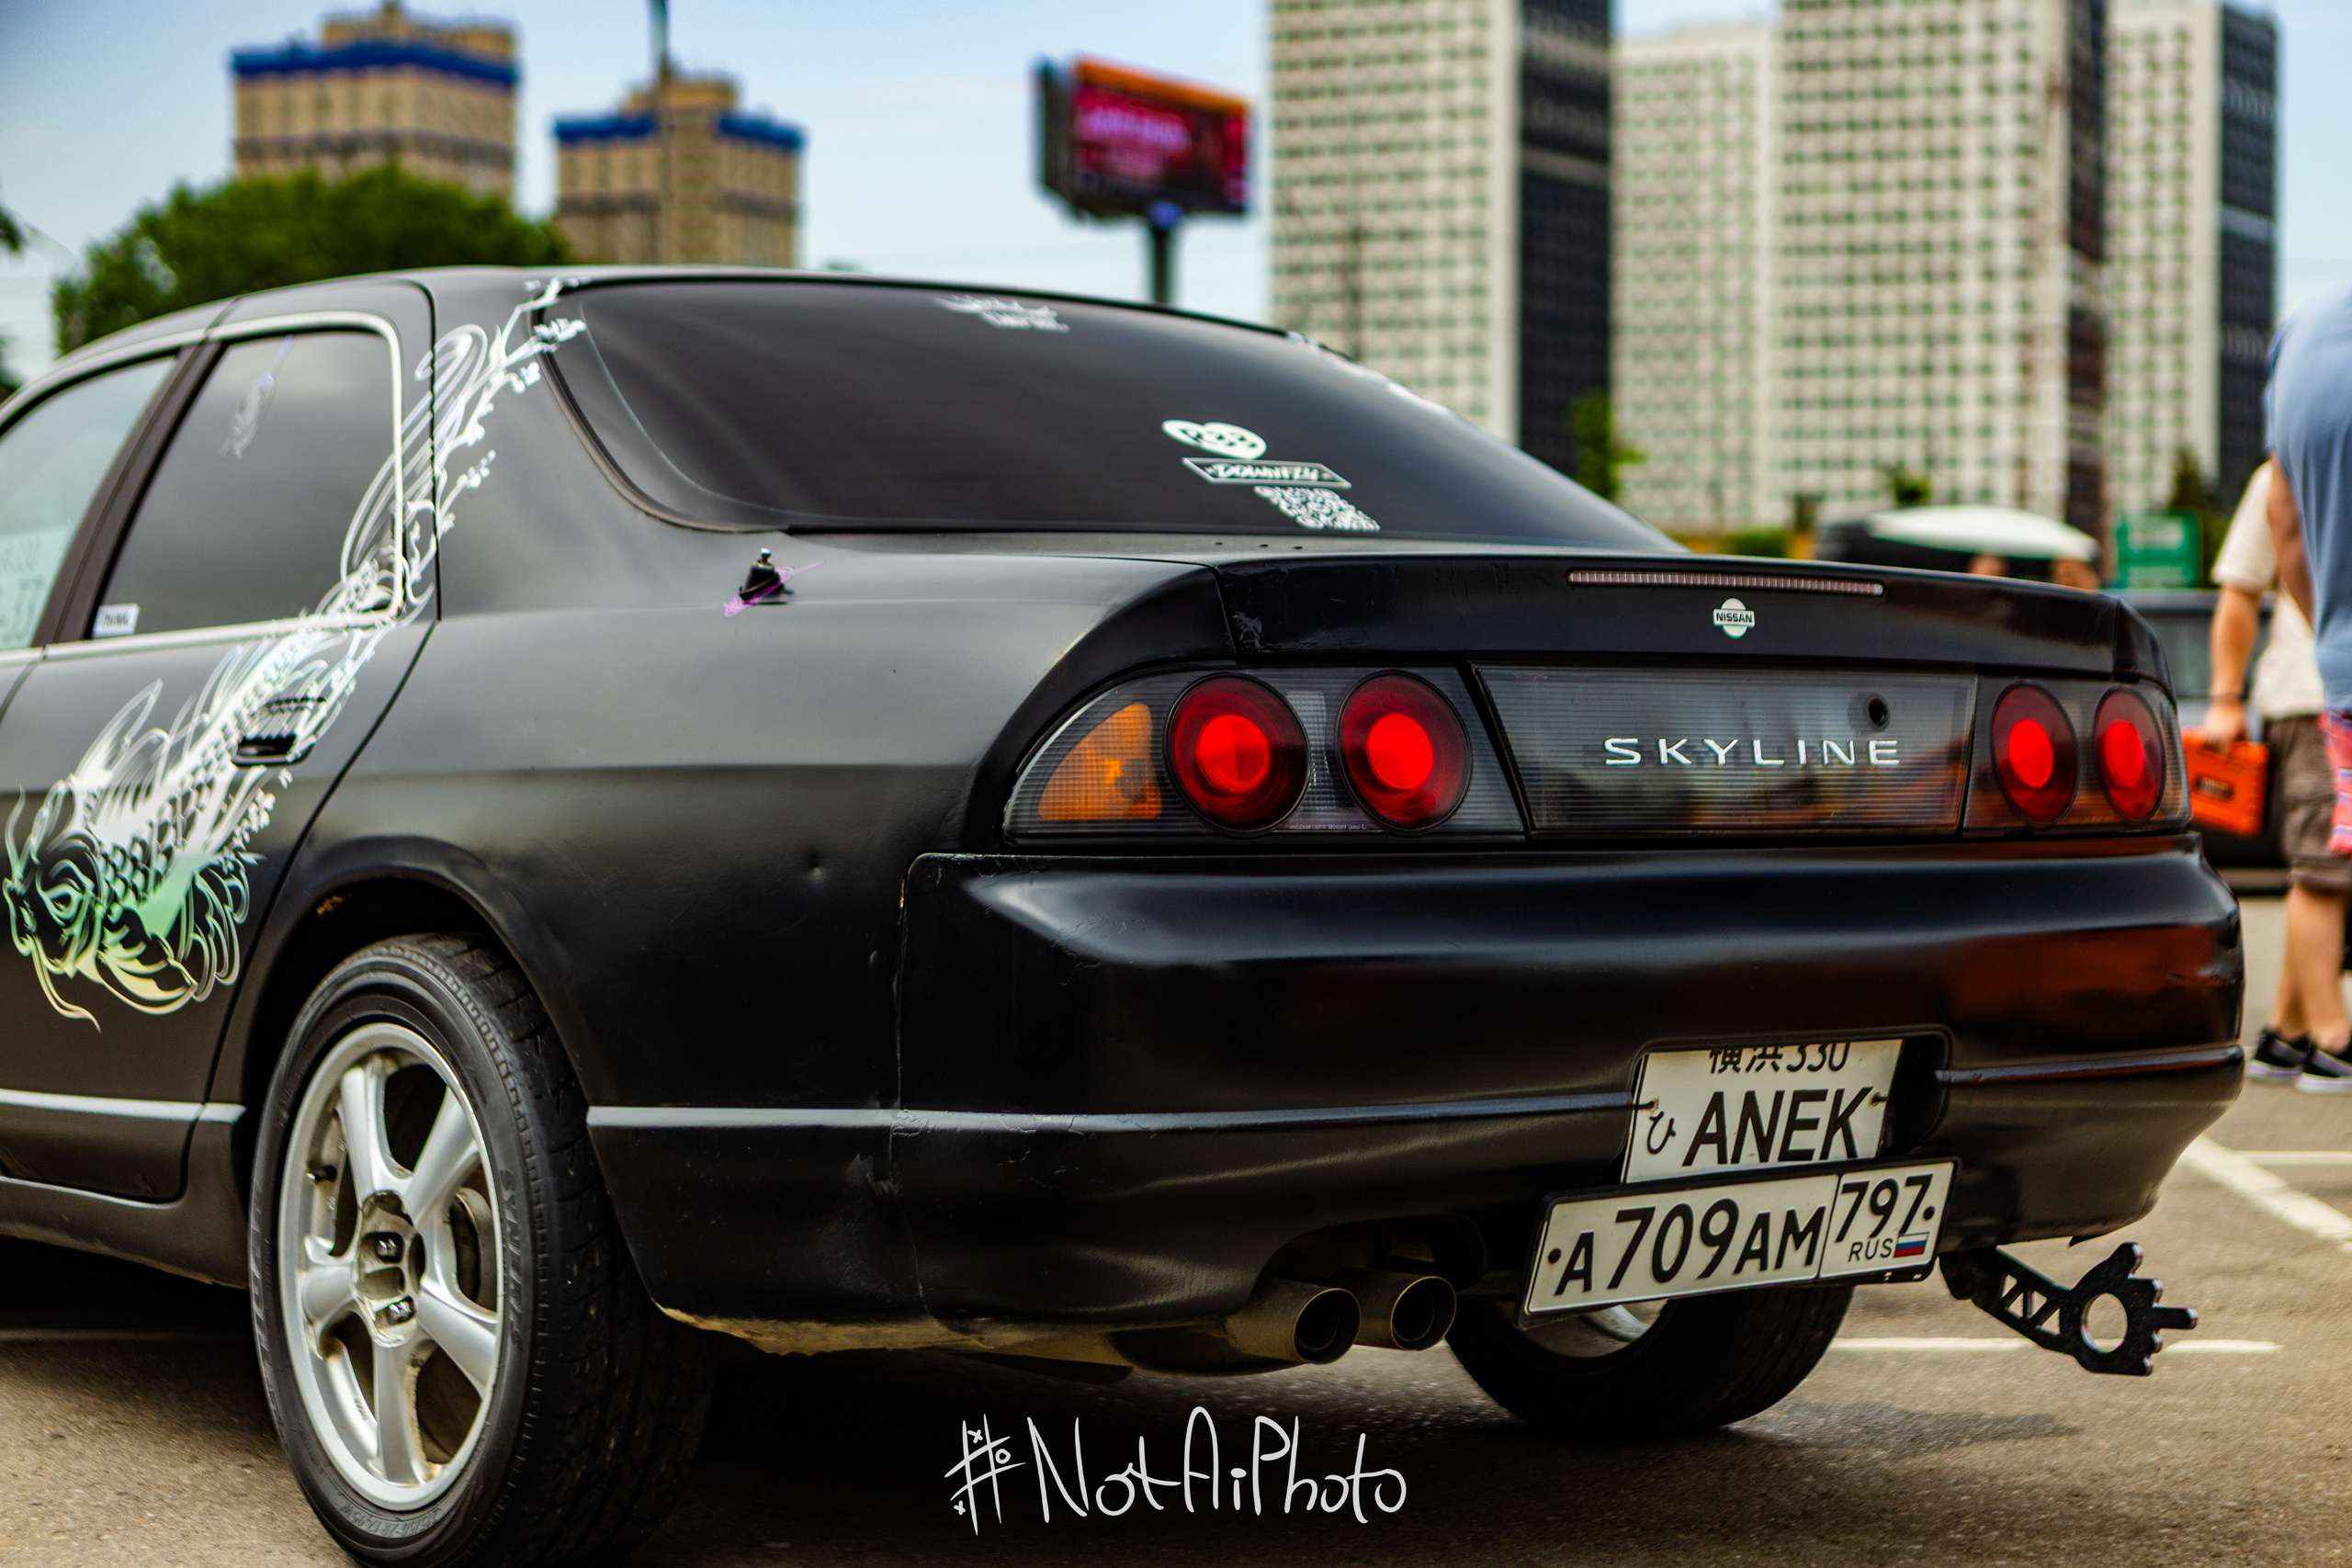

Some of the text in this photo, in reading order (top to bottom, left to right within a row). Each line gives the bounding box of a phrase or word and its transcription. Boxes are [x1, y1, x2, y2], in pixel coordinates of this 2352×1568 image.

[1715, 612, 1753, 623] NISSAN
[1604, 738, 1900, 766] SKYLINE
[1681, 1086, 1874, 1167] ANEK
[1835, 1173, 1934, 1243] 797
[1848, 1237, 1894, 1263] RUS
